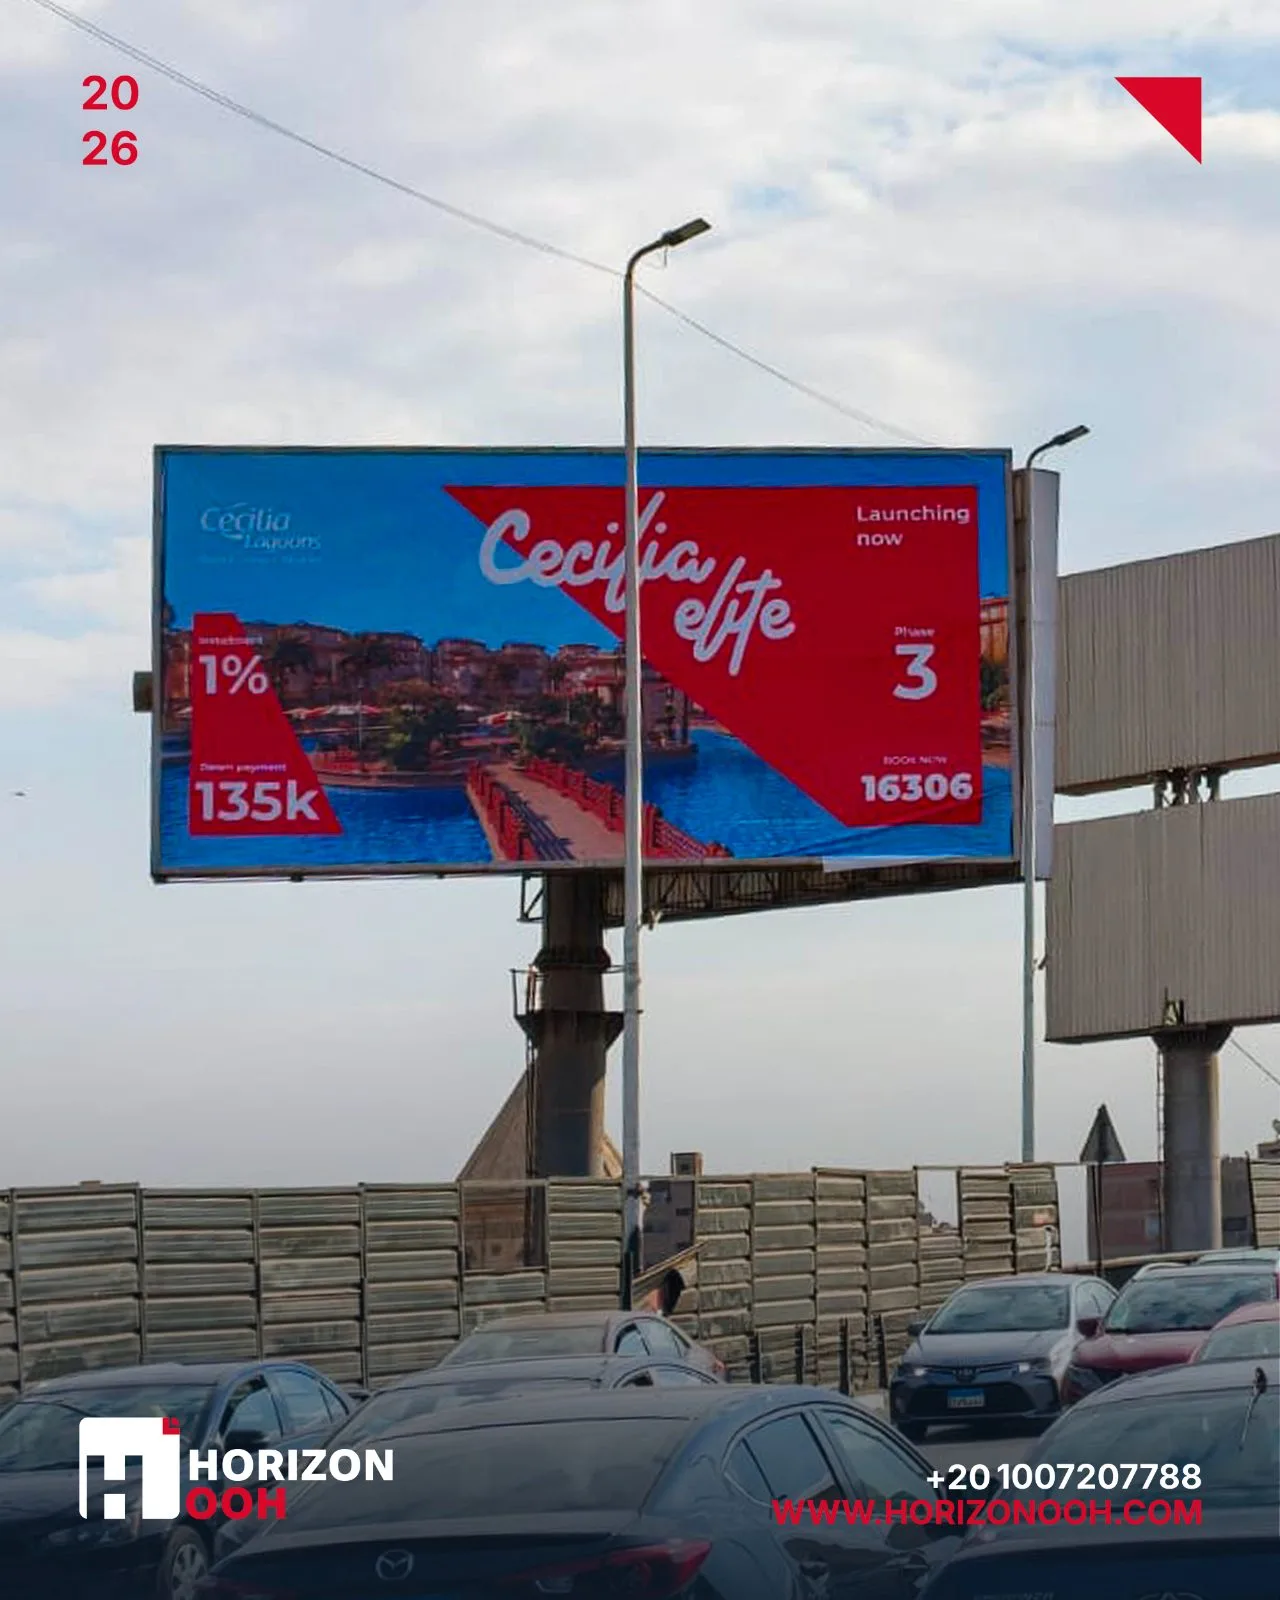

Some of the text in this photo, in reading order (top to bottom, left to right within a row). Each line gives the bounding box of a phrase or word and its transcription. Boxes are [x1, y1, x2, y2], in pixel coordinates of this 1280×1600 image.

[200, 503, 292, 540] Cecilia
[857, 504, 970, 524] Launching
[857, 533, 903, 546] now
[479, 491, 795, 677] Cecilia elite
[199, 654, 269, 695] 1%
[893, 644, 938, 700] 3
[195, 779, 320, 821] 135k
[861, 773, 973, 801] 16306
